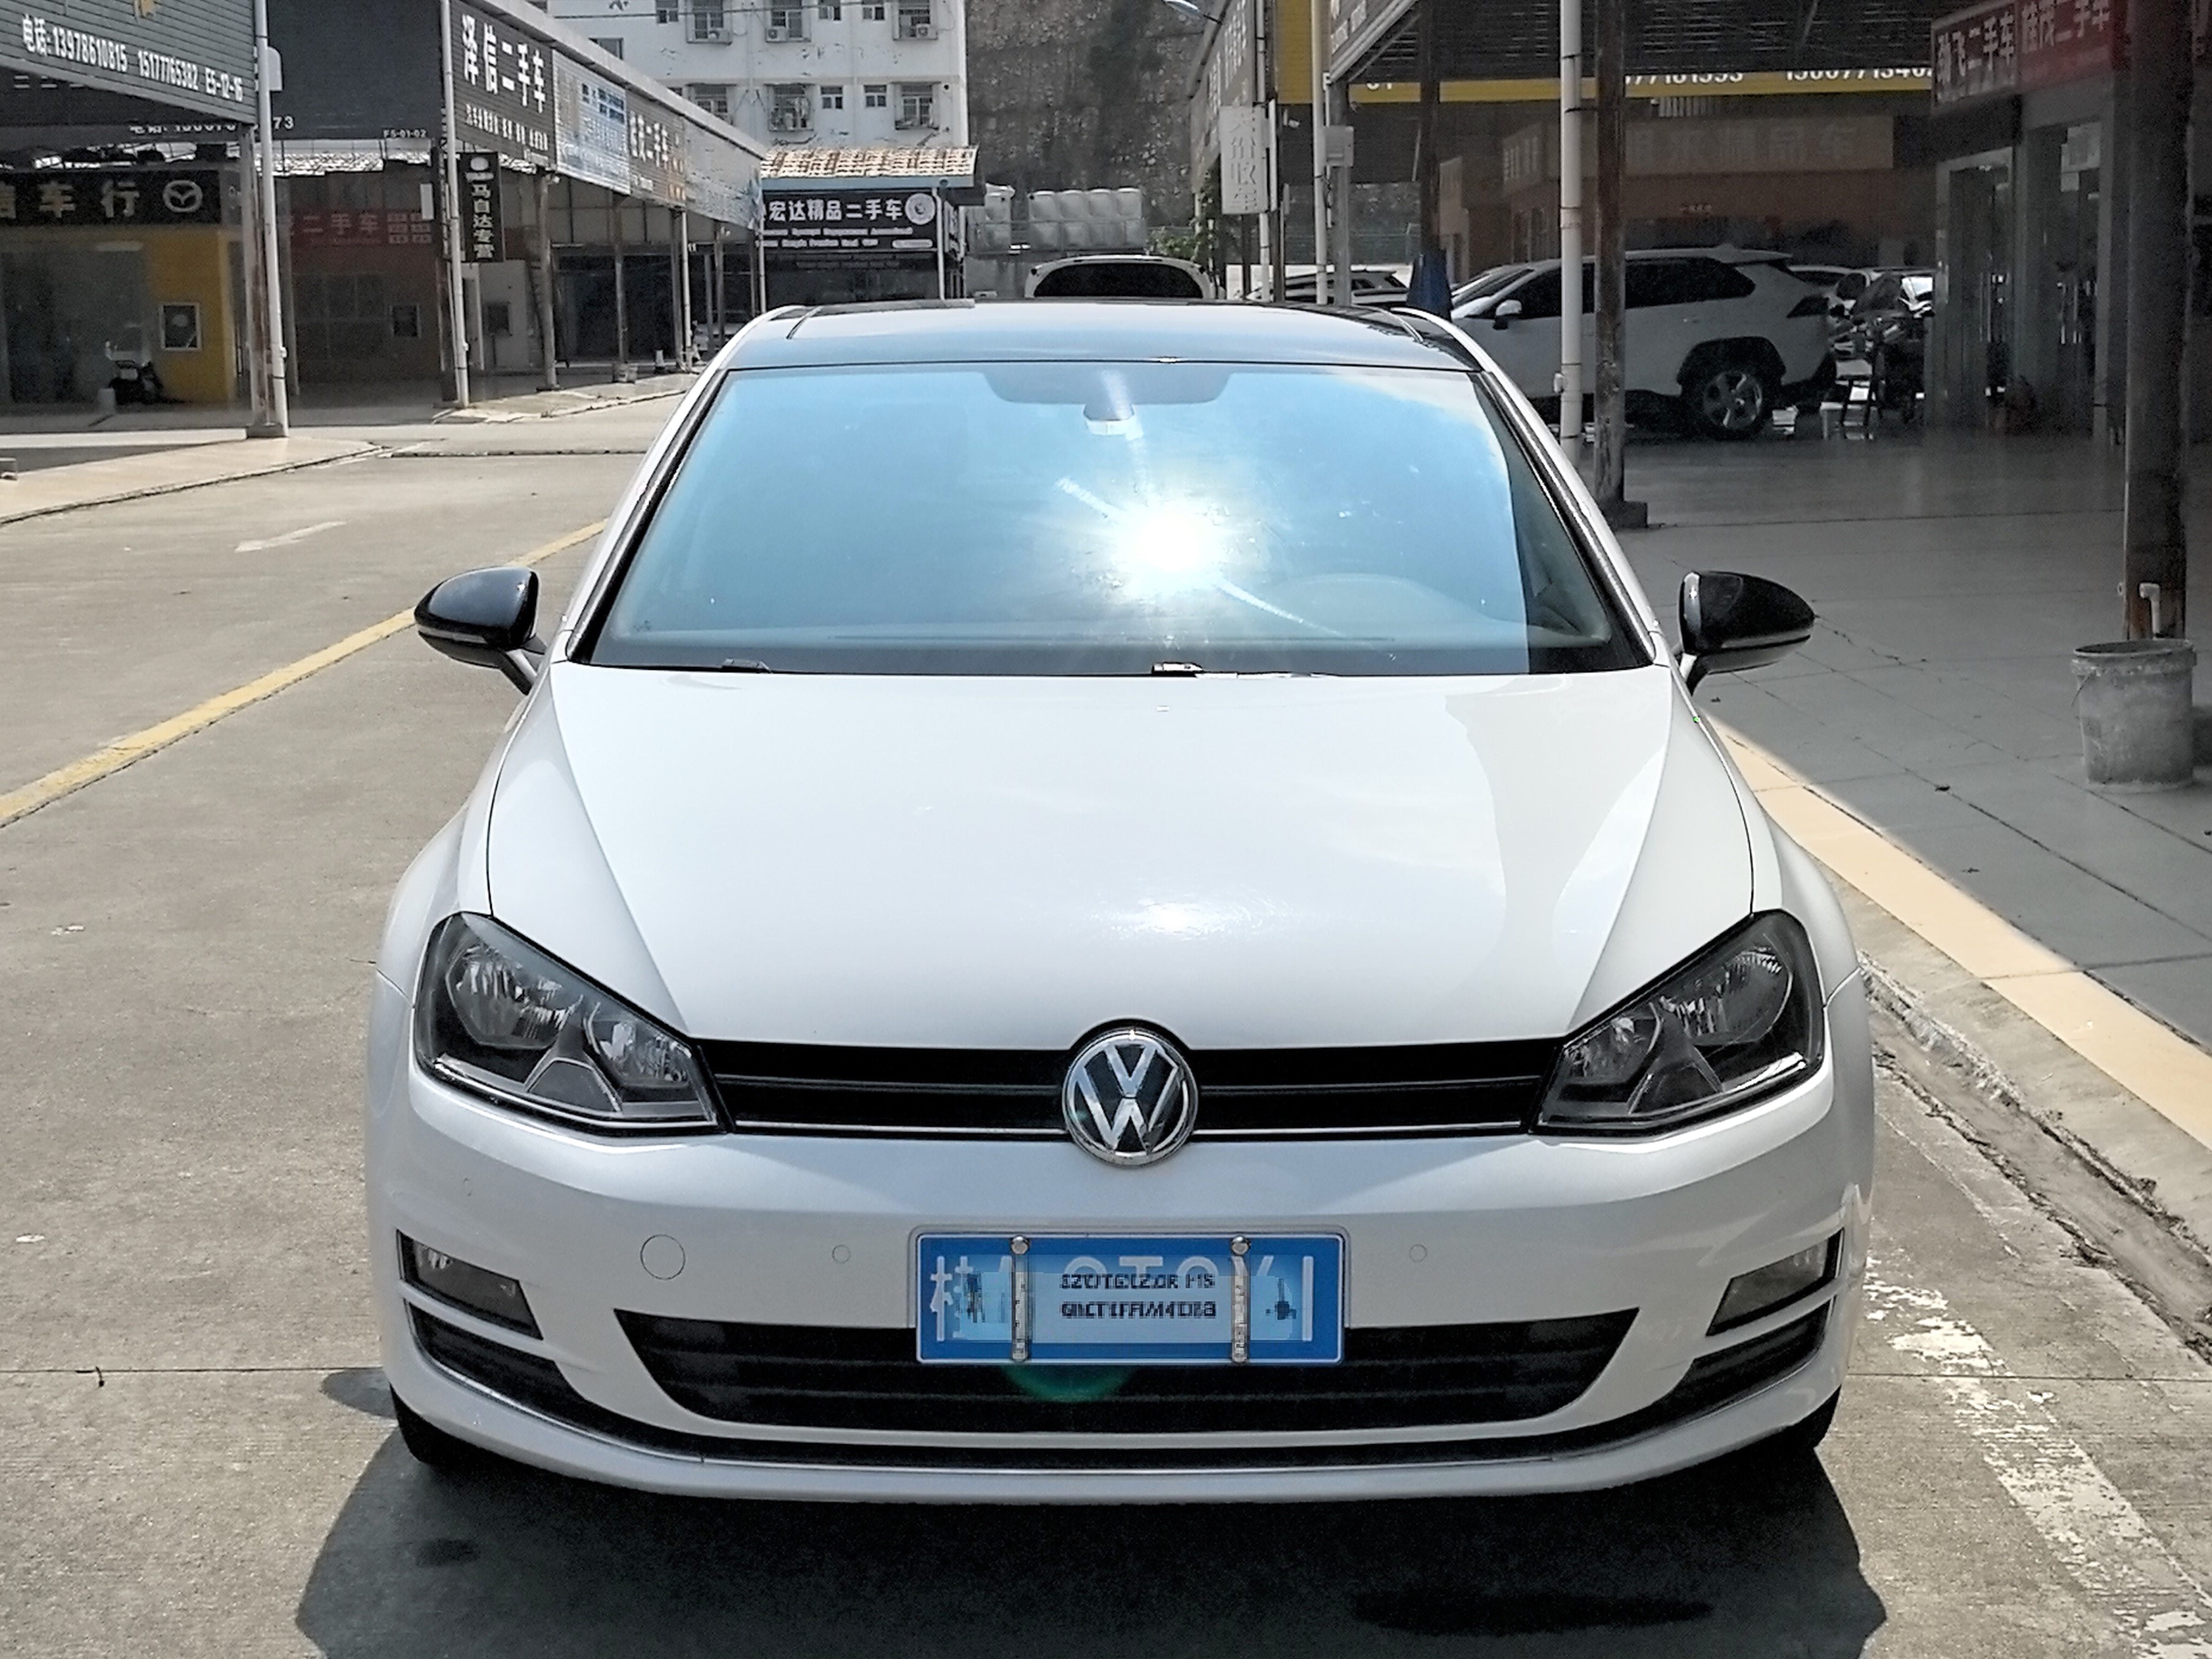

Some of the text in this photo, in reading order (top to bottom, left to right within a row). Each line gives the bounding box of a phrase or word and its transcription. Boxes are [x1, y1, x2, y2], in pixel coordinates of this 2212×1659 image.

[769, 199, 903, 221] 宏达精品二手车
